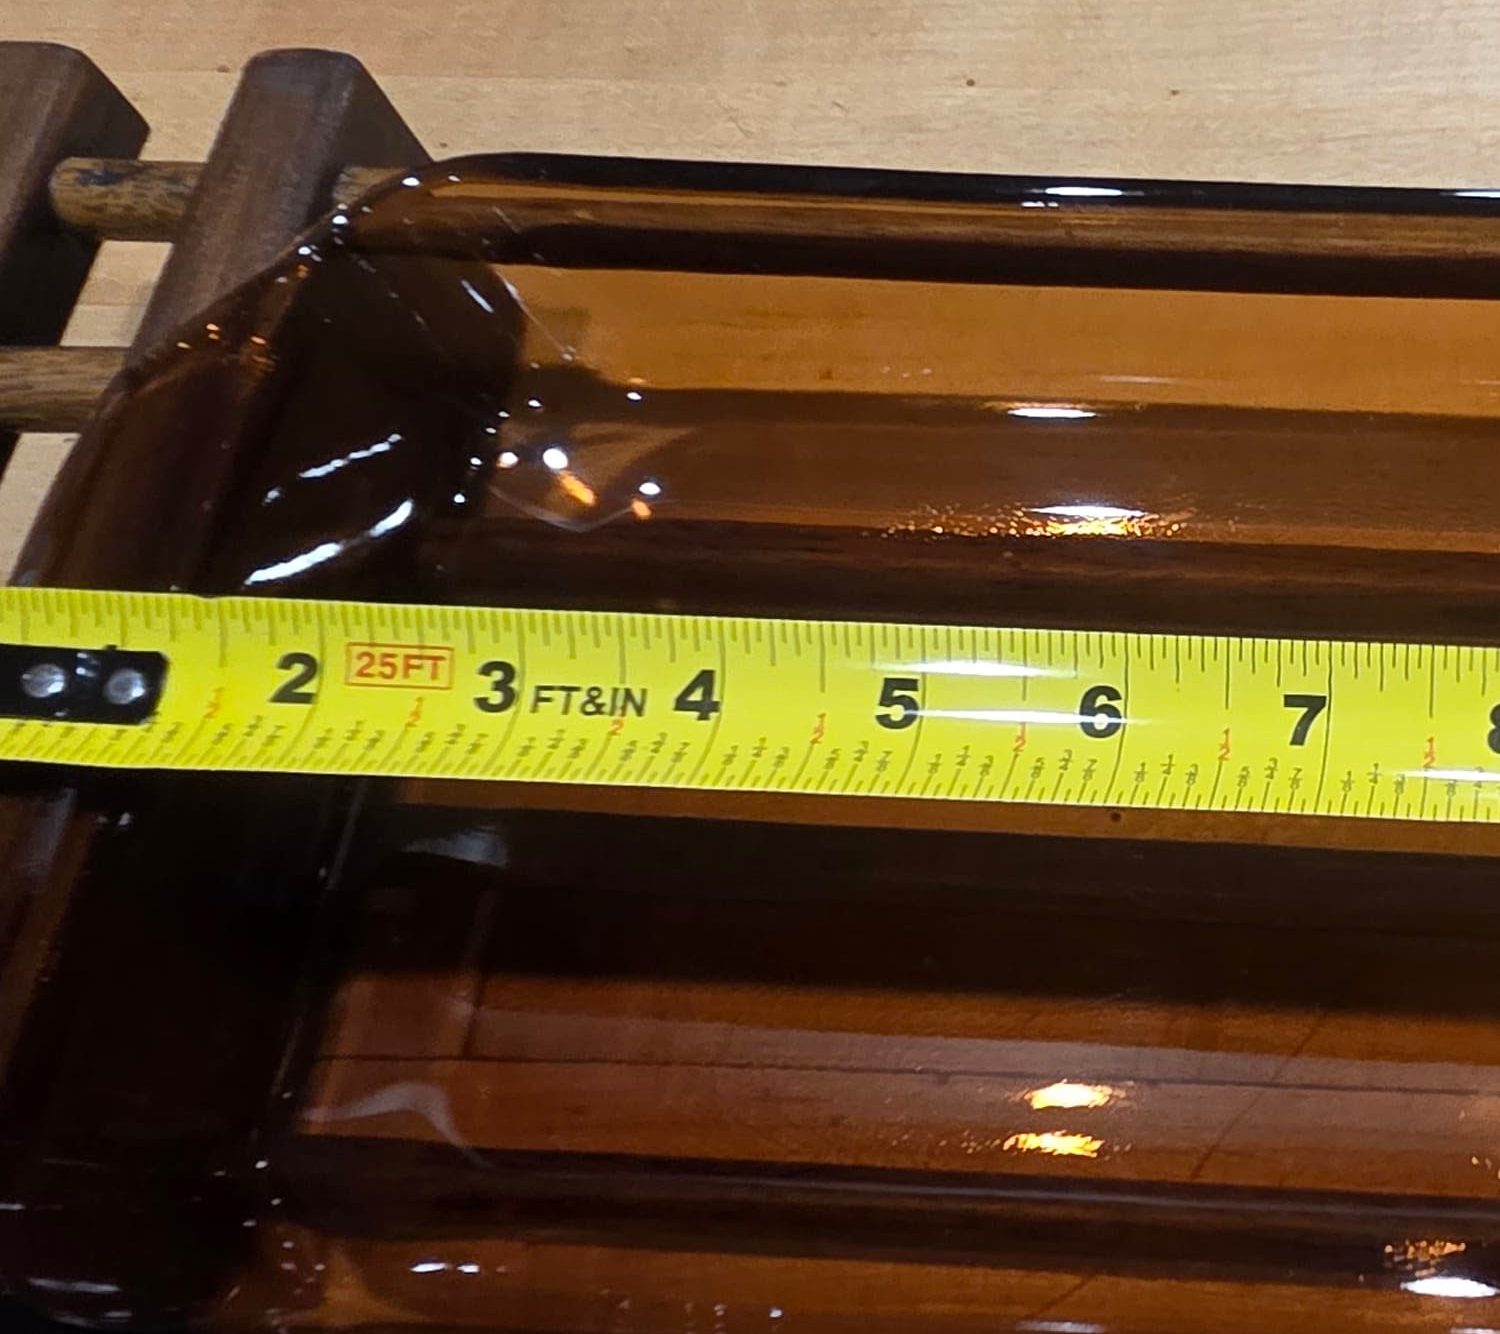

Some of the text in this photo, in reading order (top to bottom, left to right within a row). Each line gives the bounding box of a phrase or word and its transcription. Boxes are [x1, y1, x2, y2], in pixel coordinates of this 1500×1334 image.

[269, 652, 319, 704] 2
[355, 651, 447, 681] 25FT
[474, 660, 518, 713] 3
[530, 684, 648, 718] FT&IN
[673, 669, 721, 721] 4
[875, 677, 920, 729] 5
[1079, 685, 1123, 738] 6
[1283, 694, 1327, 746] 7
